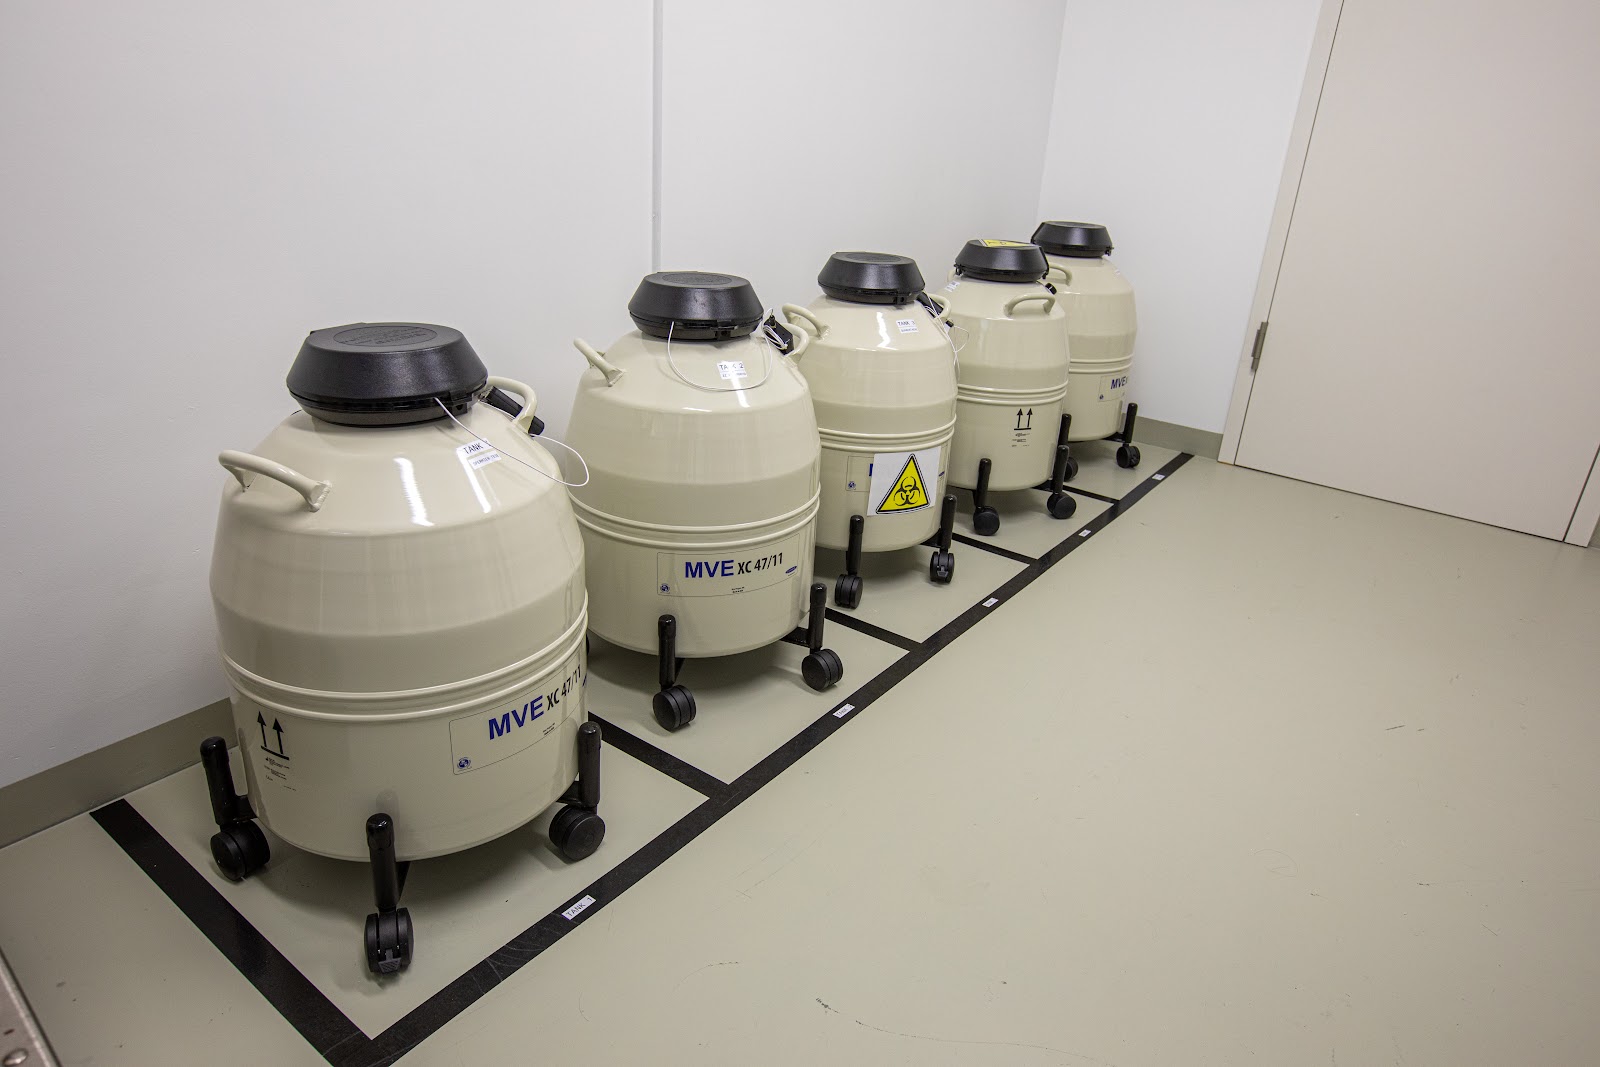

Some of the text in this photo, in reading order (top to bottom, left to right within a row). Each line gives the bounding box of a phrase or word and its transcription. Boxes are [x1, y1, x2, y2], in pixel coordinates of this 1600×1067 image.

[463, 442, 484, 454] TANK
[685, 559, 734, 578] MVE
[737, 560, 752, 575] XC
[754, 552, 783, 572] 47/11
[488, 664, 581, 740] MVE XC 47/11
[566, 903, 586, 917] TANK
